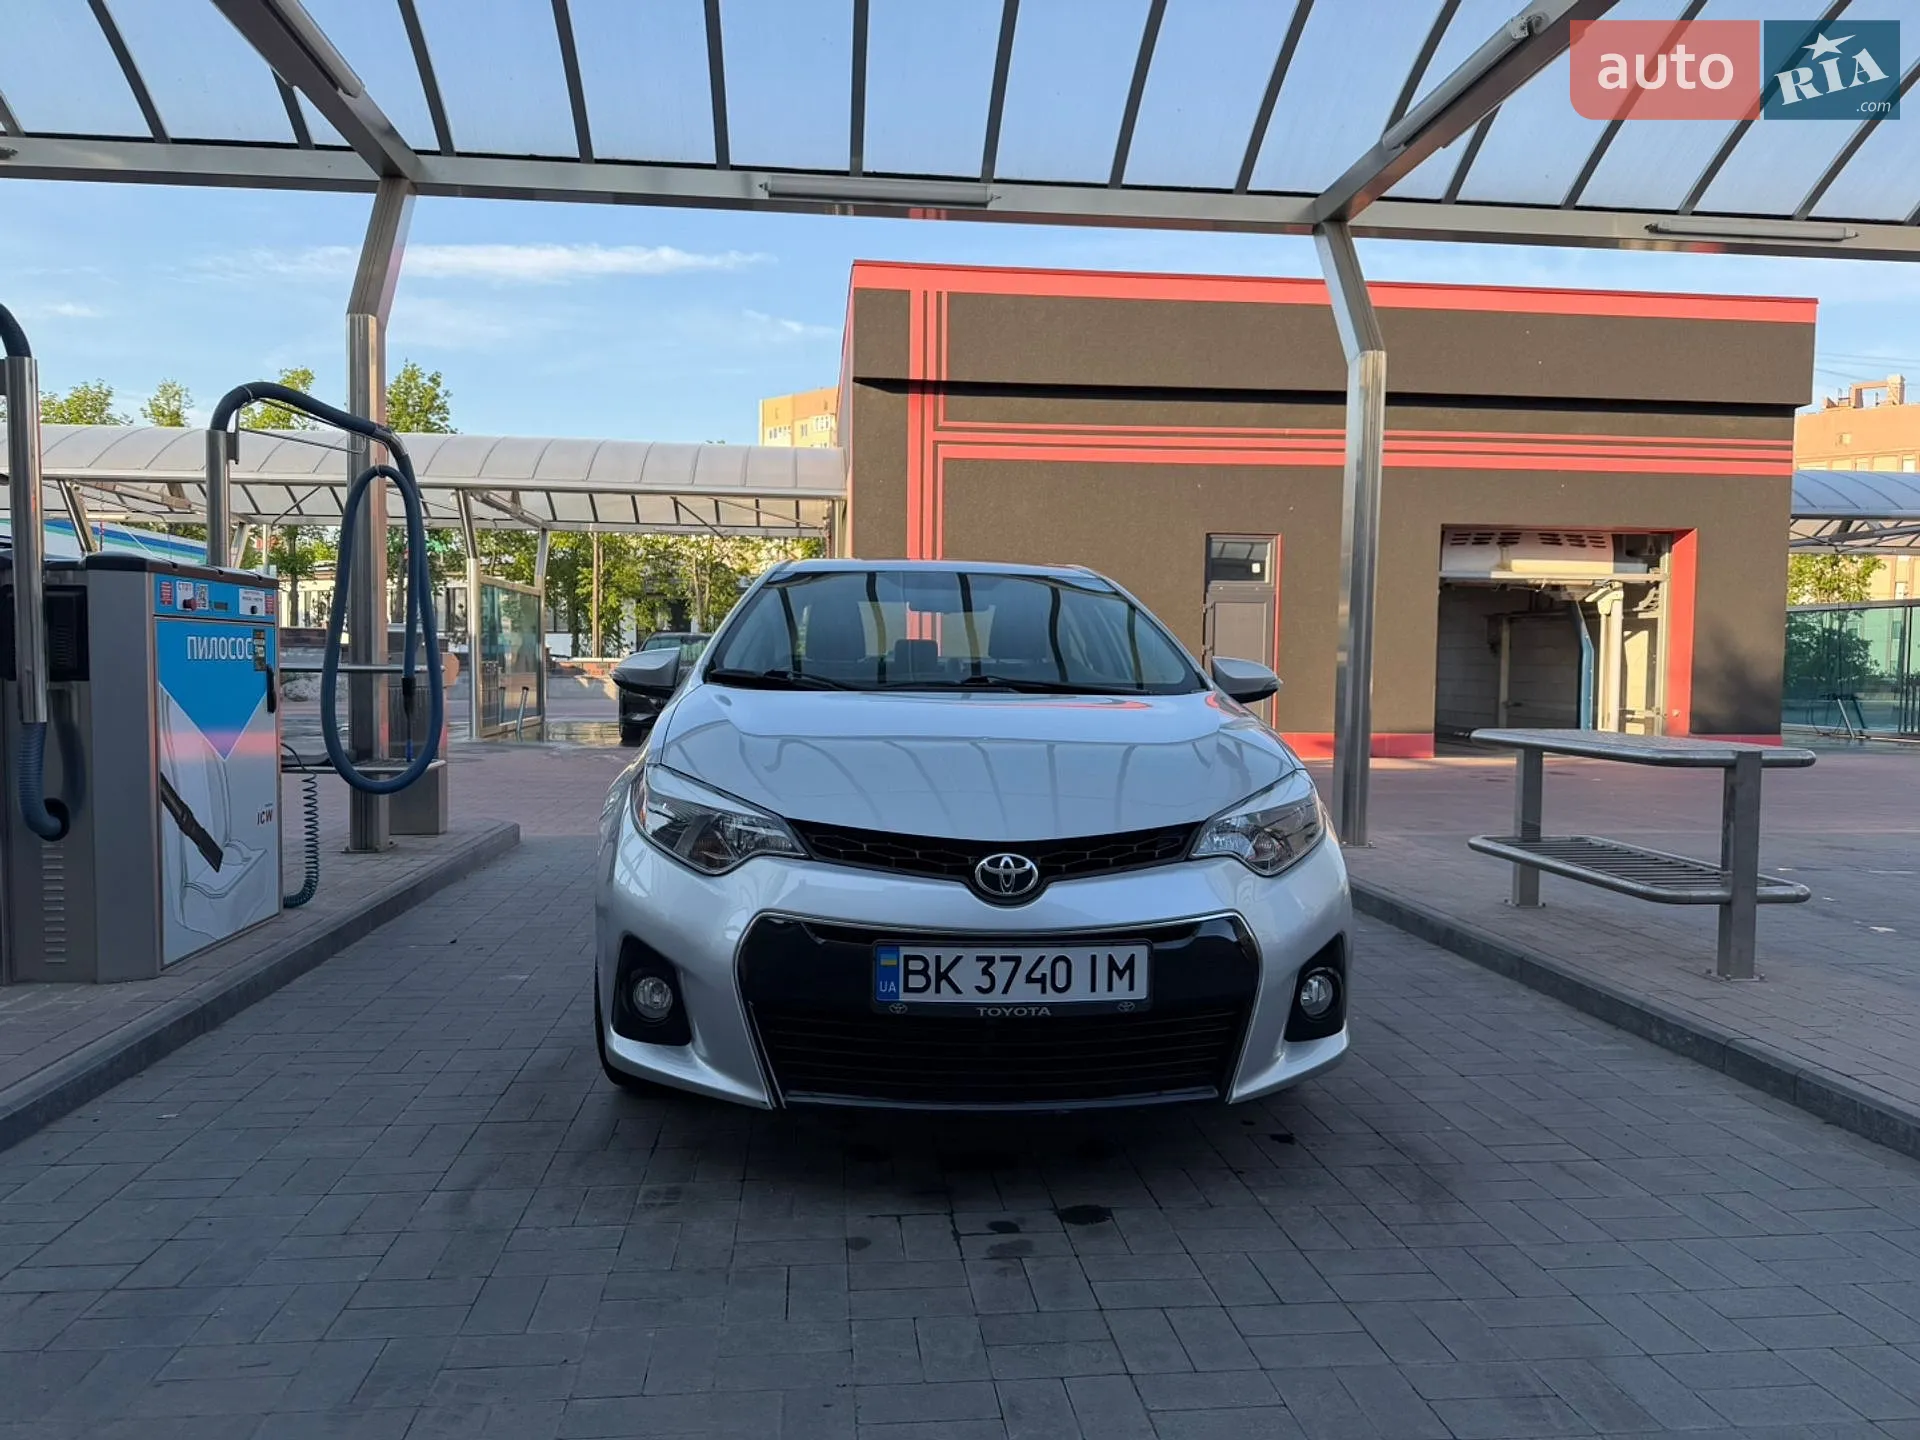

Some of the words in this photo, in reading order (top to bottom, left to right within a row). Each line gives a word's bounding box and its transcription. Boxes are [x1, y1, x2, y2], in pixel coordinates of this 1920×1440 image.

[187, 635, 253, 660] ПИЛОСОС
[902, 954, 963, 994] BK
[974, 954, 1072, 994] 3740
[1089, 953, 1136, 993] IM
[879, 980, 897, 993] UA
[975, 1006, 1051, 1017] TOYOTA
